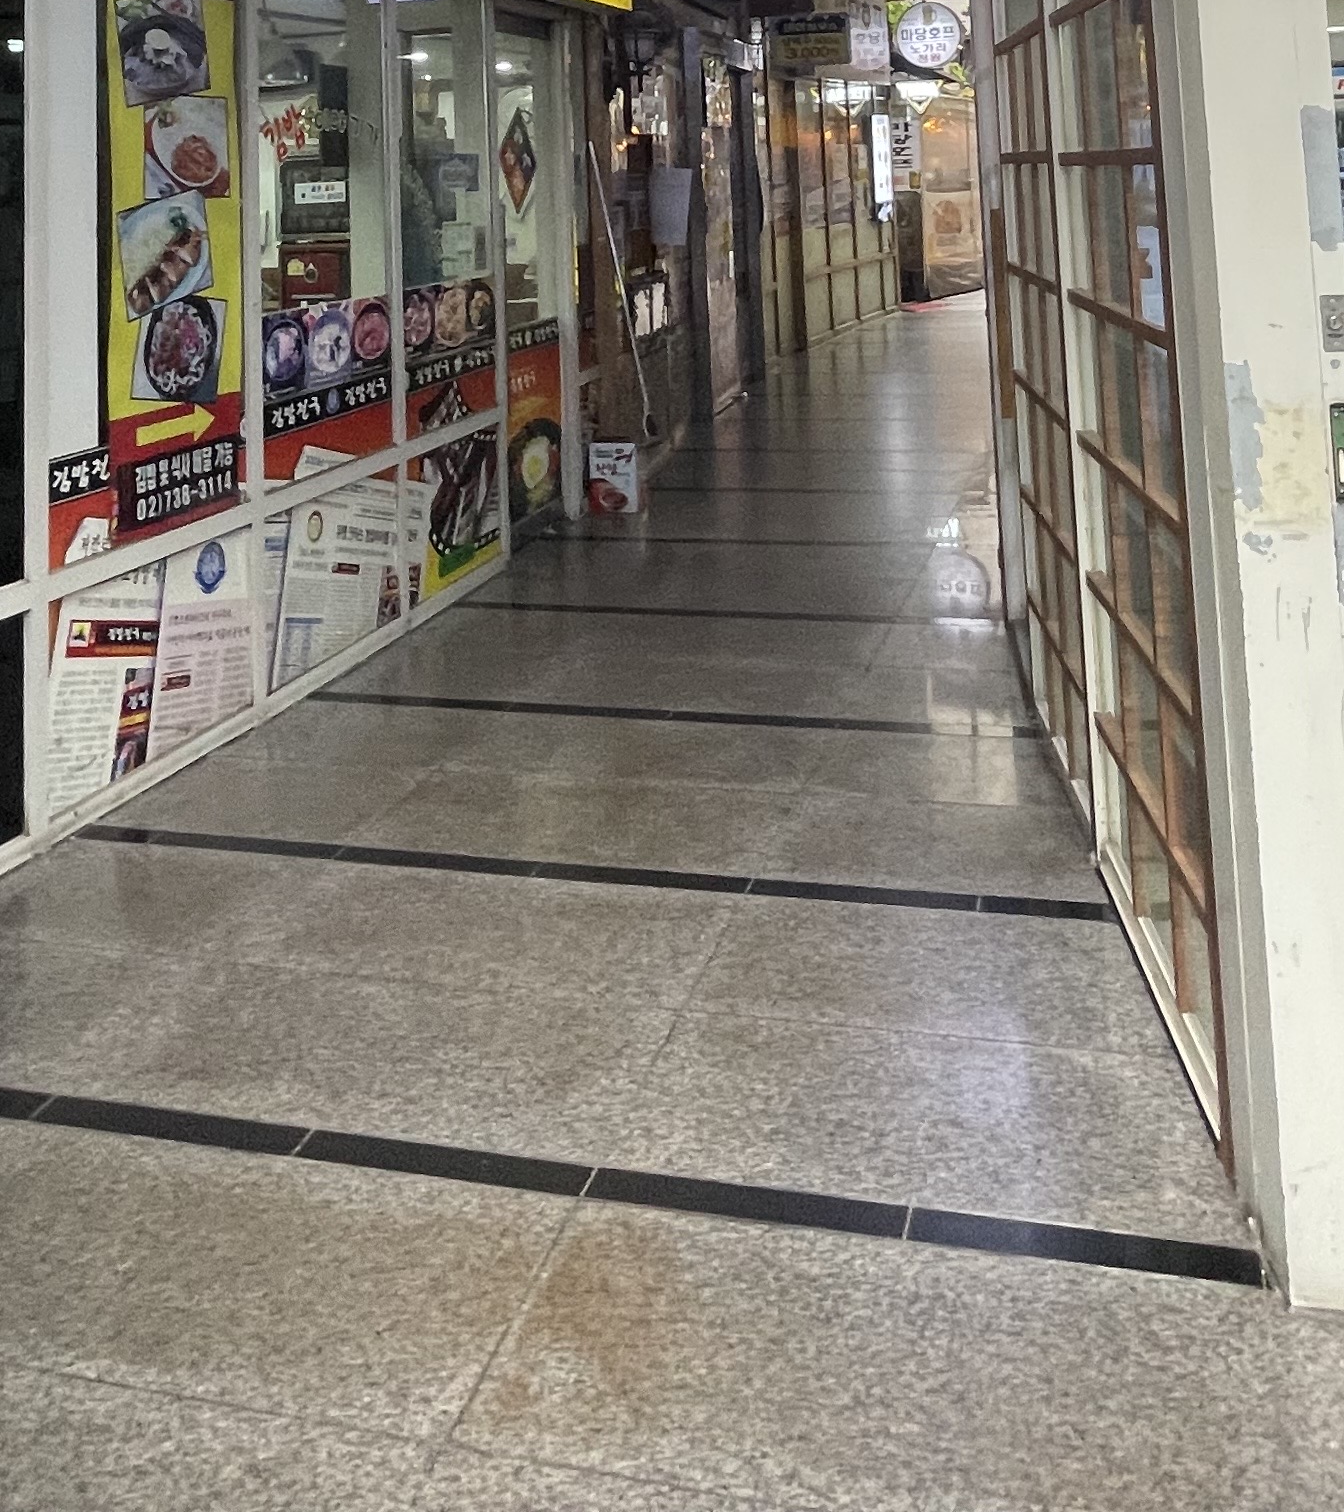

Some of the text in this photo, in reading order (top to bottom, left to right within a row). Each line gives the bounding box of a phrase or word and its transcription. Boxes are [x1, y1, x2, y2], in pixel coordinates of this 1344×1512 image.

[901, 25, 955, 42] 마당호프
[910, 43, 947, 54] 노가리
[271, 397, 321, 429] 김밥천국
